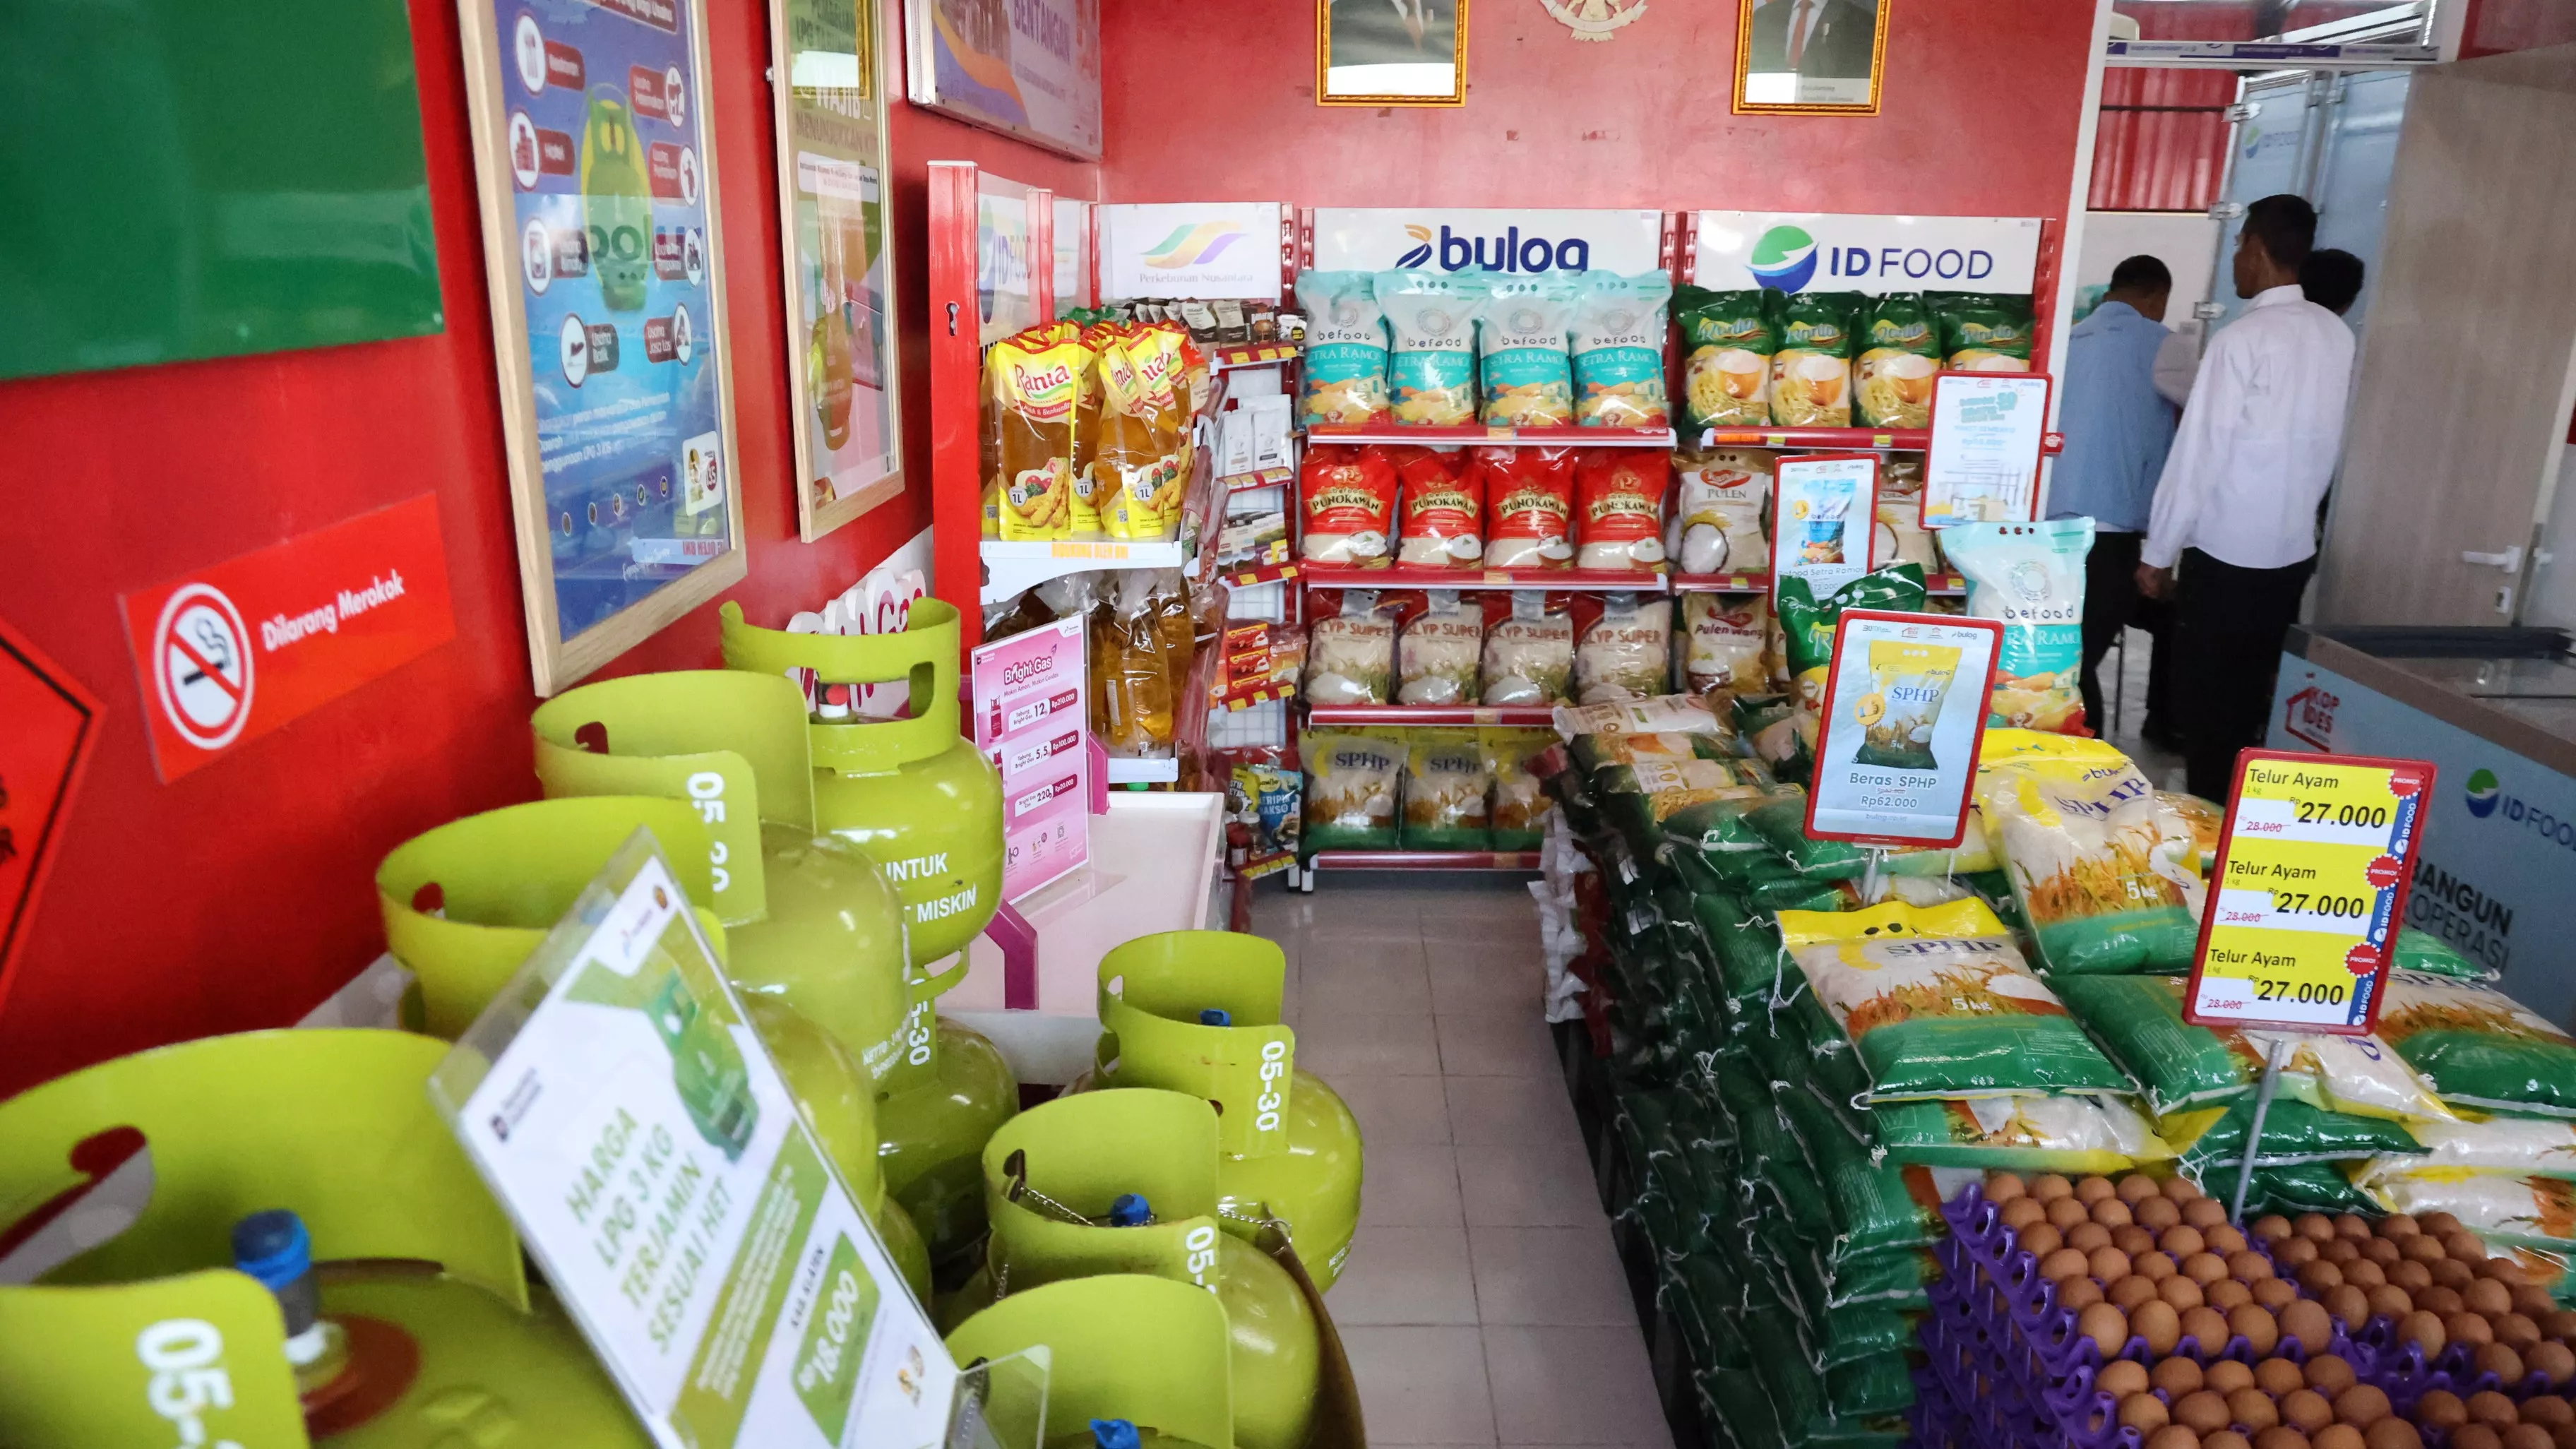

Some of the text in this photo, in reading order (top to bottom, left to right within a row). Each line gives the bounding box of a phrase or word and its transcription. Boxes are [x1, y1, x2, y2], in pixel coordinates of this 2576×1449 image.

[1830, 246, 1993, 280] ID FOOD
[1139, 273, 1253, 283] Perkebunan Nusantara
[1408, 338, 1461, 347] befood
[1501, 335, 1556, 345] befood
[1527, 352, 1561, 364] RAMO
[1618, 350, 1652, 363] RAMO
[1014, 363, 1070, 398] Rania
[1043, 402, 1070, 416] Berkualit
[1707, 489, 1747, 499] PULEN
[1312, 494, 1379, 511] PUNOKAWAN
[1412, 498, 1474, 514] PUNOKAWAN
[1502, 497, 1567, 515] PUNOKAWAN
[1811, 568, 1834, 576] Setra
[261, 568, 405, 651] Dilarang Merokok
[2003, 605, 2074, 619] befood
[1527, 626, 1569, 639] SUPER
[1586, 629, 1661, 644] LYP SUPER
[1695, 624, 1764, 638] Pulen Wang
[1957, 631, 1977, 640] bulog
[2032, 629, 2080, 645] RAMO
[1004, 657, 1052, 684] Bright Gas
[1003, 688, 1017, 697] Makin
[1052, 693, 1075, 708] Rp210.000
[1892, 686, 1939, 703] SPHP
[1016, 710, 1030, 718] Tabung
[1034, 703, 1044, 717] 12
[1013, 716, 1025, 725] Bright
[1053, 735, 1076, 751] Rp100.000
[1015, 759, 1027, 768] Bright
[1018, 752, 1031, 761] Tabung
[1335, 752, 1390, 771] SPHP
[1055, 778, 1074, 792] Rp20.000
[1850, 773, 1936, 789] Beras SPHP
[2250, 769, 2339, 789] Telur Ayam
[1019, 797, 1029, 806] Bright
[1861, 796, 1918, 808] Rp62.000
[2289, 797, 2386, 829] Rp 27.000
[2404, 803, 2416, 827] FOOD
[2246, 821, 2282, 832] 28.000
[2501, 795, 2576, 849] ID FOO
[2229, 861, 2316, 880] Telur Ayam
[2126, 881, 2140, 900] 5
[917, 883, 977, 923] MISKIN
[2267, 887, 2364, 919] Rp 27.000
[2382, 892, 2395, 915] FOOD
[2226, 912, 2261, 922] 28.000
[2404, 890, 2510, 972] OPERASI
[1885, 940, 2003, 959] SPHP
[2210, 949, 2296, 968] Telur Ayam
[2258, 980, 2344, 1006] 27.000
[2361, 980, 2373, 1003] FOOD
[1952, 998, 1993, 1012] 5 kg
[2207, 999, 2243, 1009] 28.000
[909, 979, 931, 1066] 5-30
[1256, 1041, 1286, 1132] 05-30
[565, 1106, 638, 1224] HARGA
[593, 1123, 674, 1270] LPG 3 KG
[620, 1151, 702, 1308] TERJAMIN
[648, 1175, 734, 1354] SESUAI HET
[1186, 1226, 1216, 1294] 05-
[813, 1270, 859, 1384] 18.000
[136, 1318, 246, 1449] 05-
